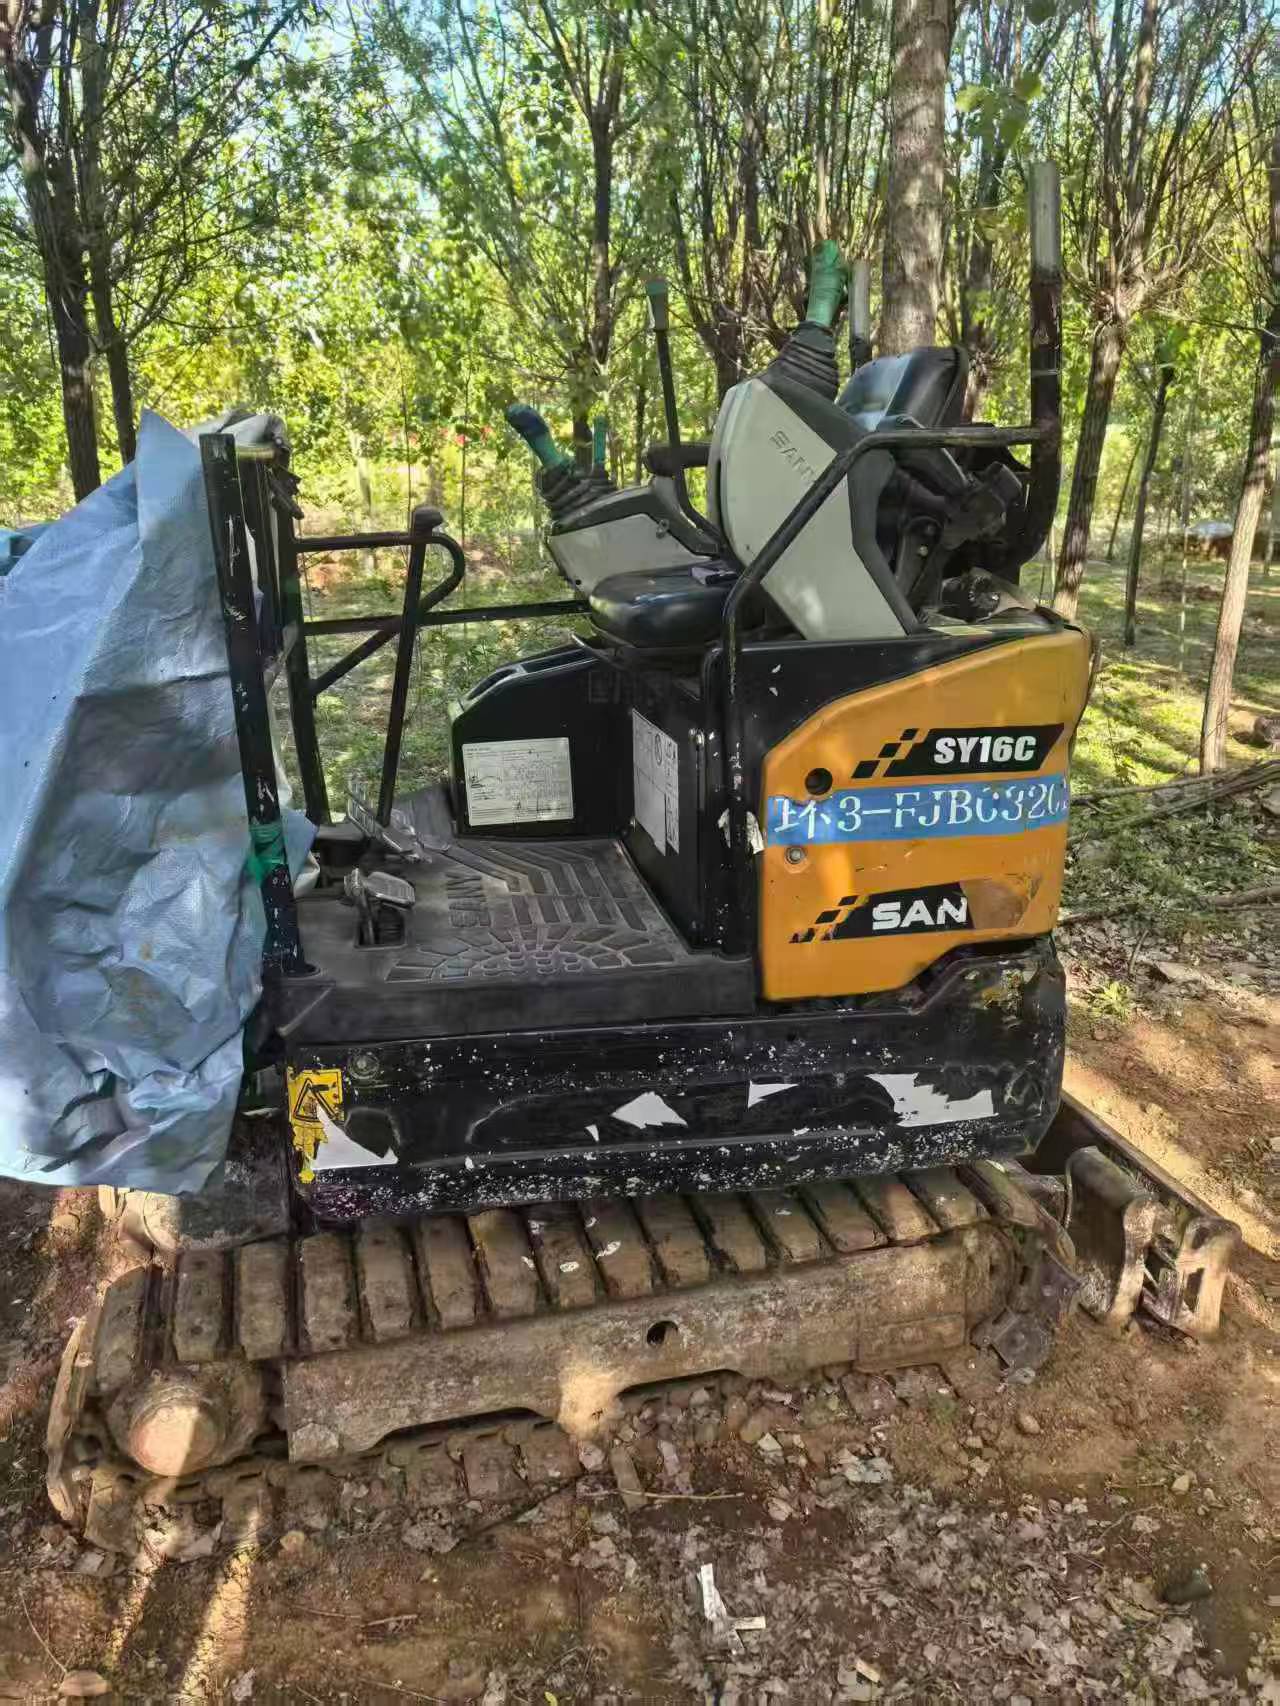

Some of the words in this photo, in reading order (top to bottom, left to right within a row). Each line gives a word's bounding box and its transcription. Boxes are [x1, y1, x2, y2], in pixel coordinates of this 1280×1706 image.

[769, 430, 815, 479] SAN
[933, 735, 1037, 765] SY16C
[872, 897, 968, 930] SAN
